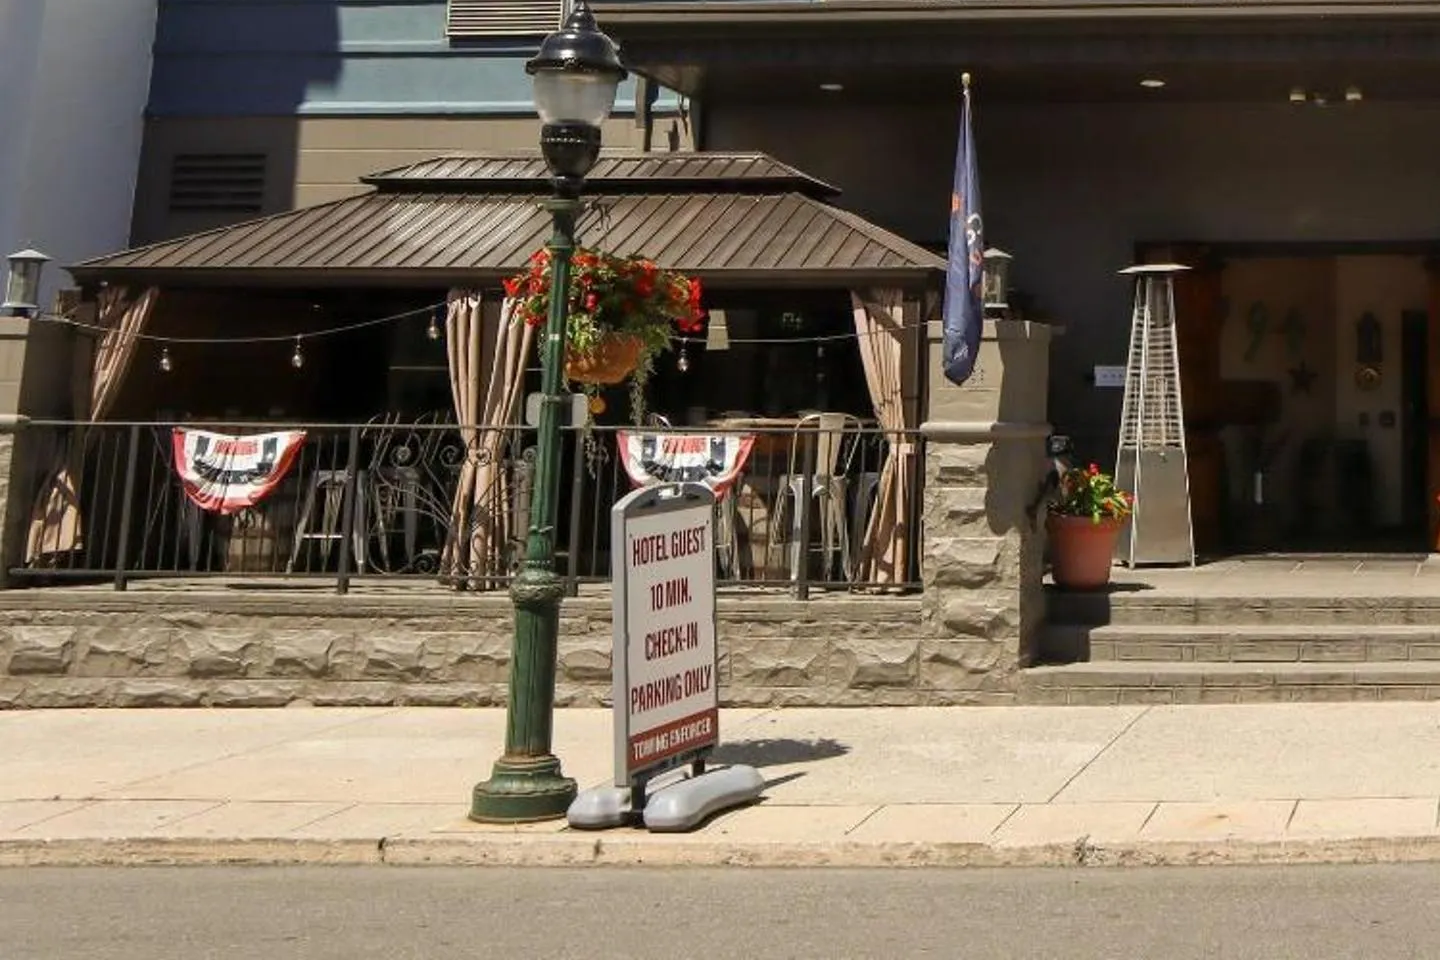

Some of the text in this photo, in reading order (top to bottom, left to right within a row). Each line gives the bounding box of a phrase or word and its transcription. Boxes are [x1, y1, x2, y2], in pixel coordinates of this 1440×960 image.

[633, 525, 706, 567] HOTEL GUEST
[650, 576, 692, 611] 10 MIN.
[644, 621, 698, 661] CHECK-IN
[631, 664, 712, 715] PARKING ONLY
